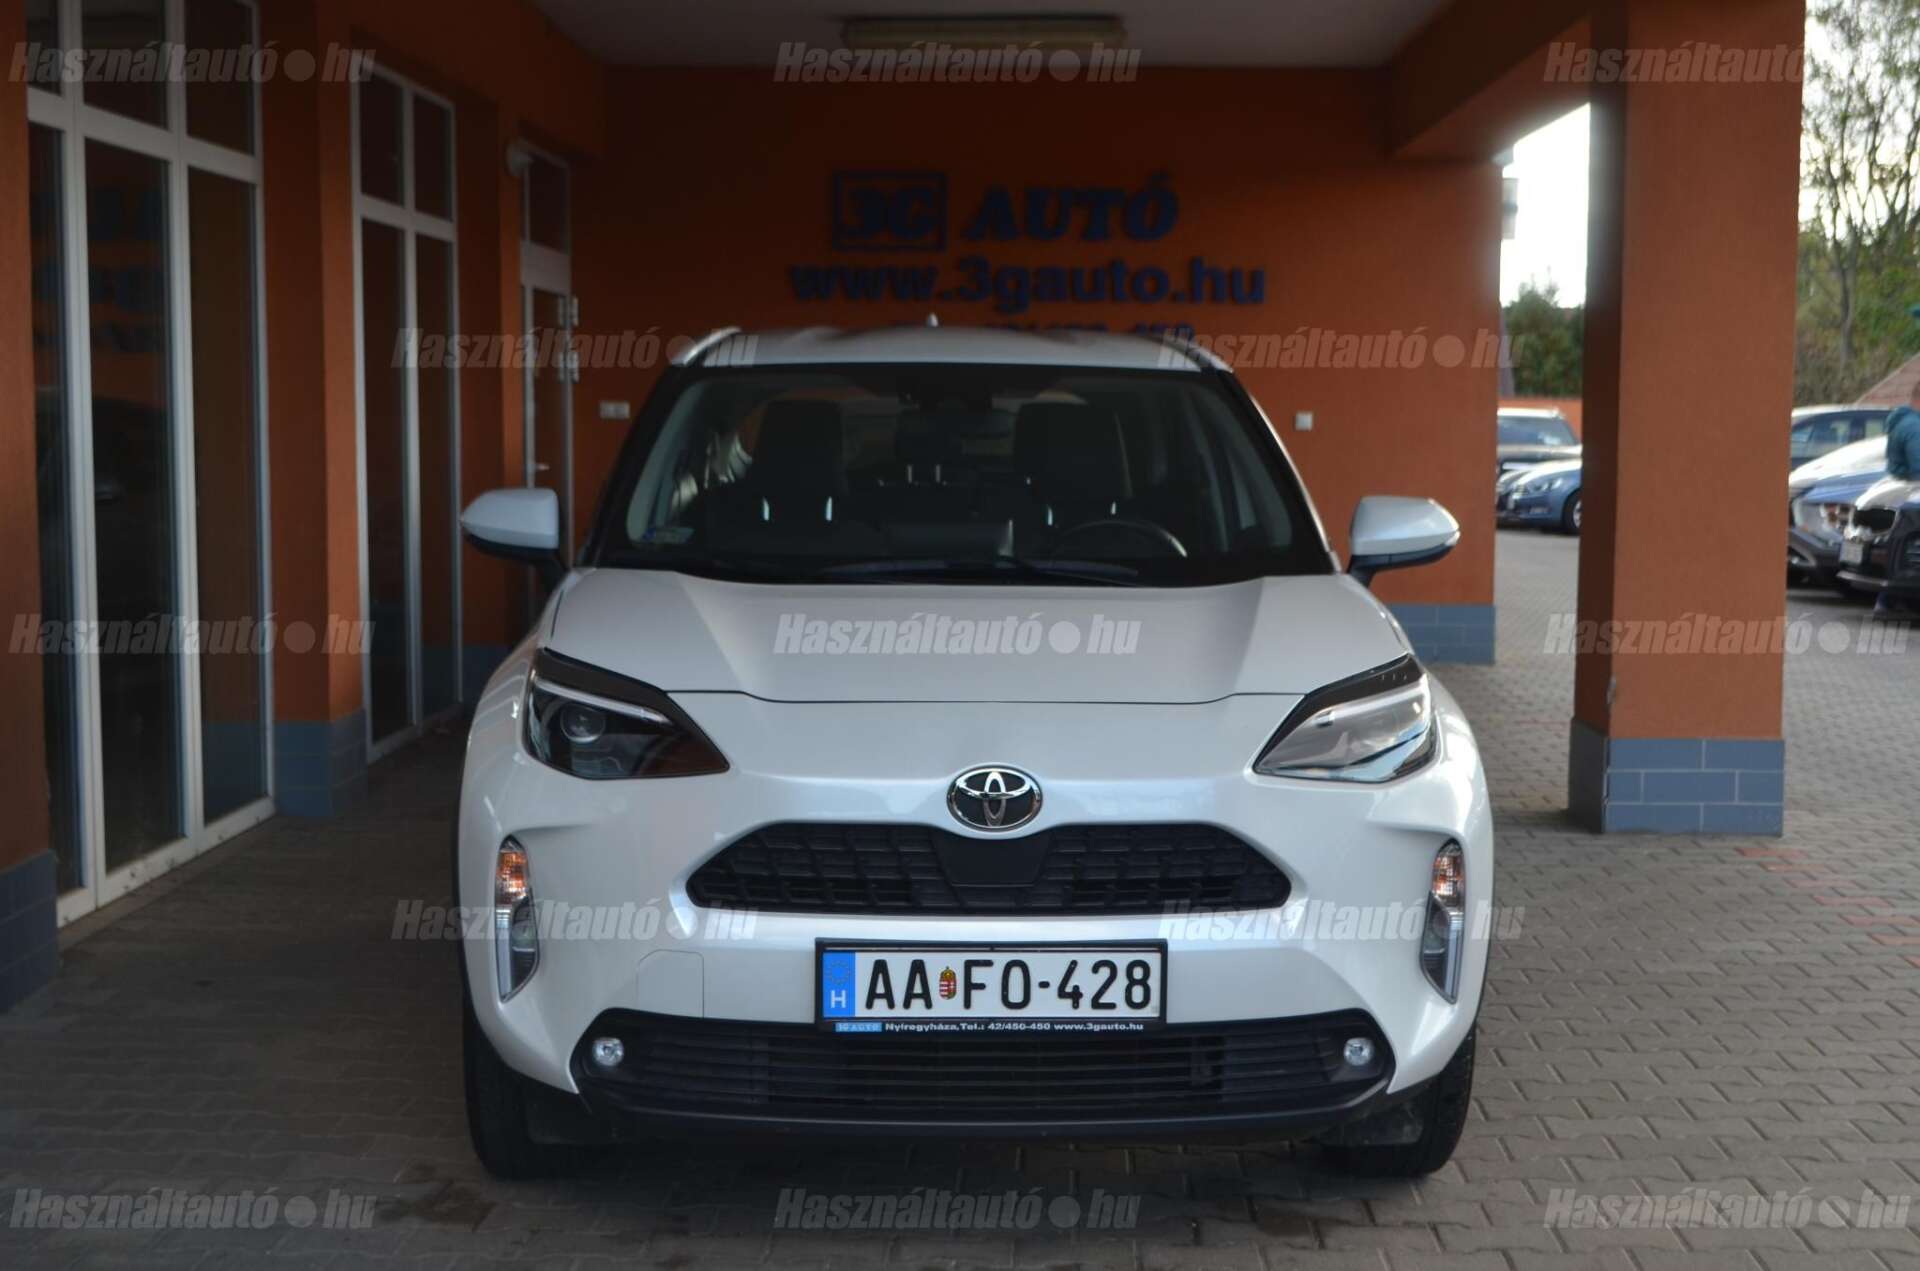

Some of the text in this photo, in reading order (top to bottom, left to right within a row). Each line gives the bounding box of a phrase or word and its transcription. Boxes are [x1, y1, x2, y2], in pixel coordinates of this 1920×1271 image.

[962, 169, 1181, 241] AUTÓ
[787, 256, 1266, 314] www.3gauto.hu
[830, 959, 1152, 1010] H AA FO-428
[1054, 1022, 1144, 1032] www.3gauto.hu
